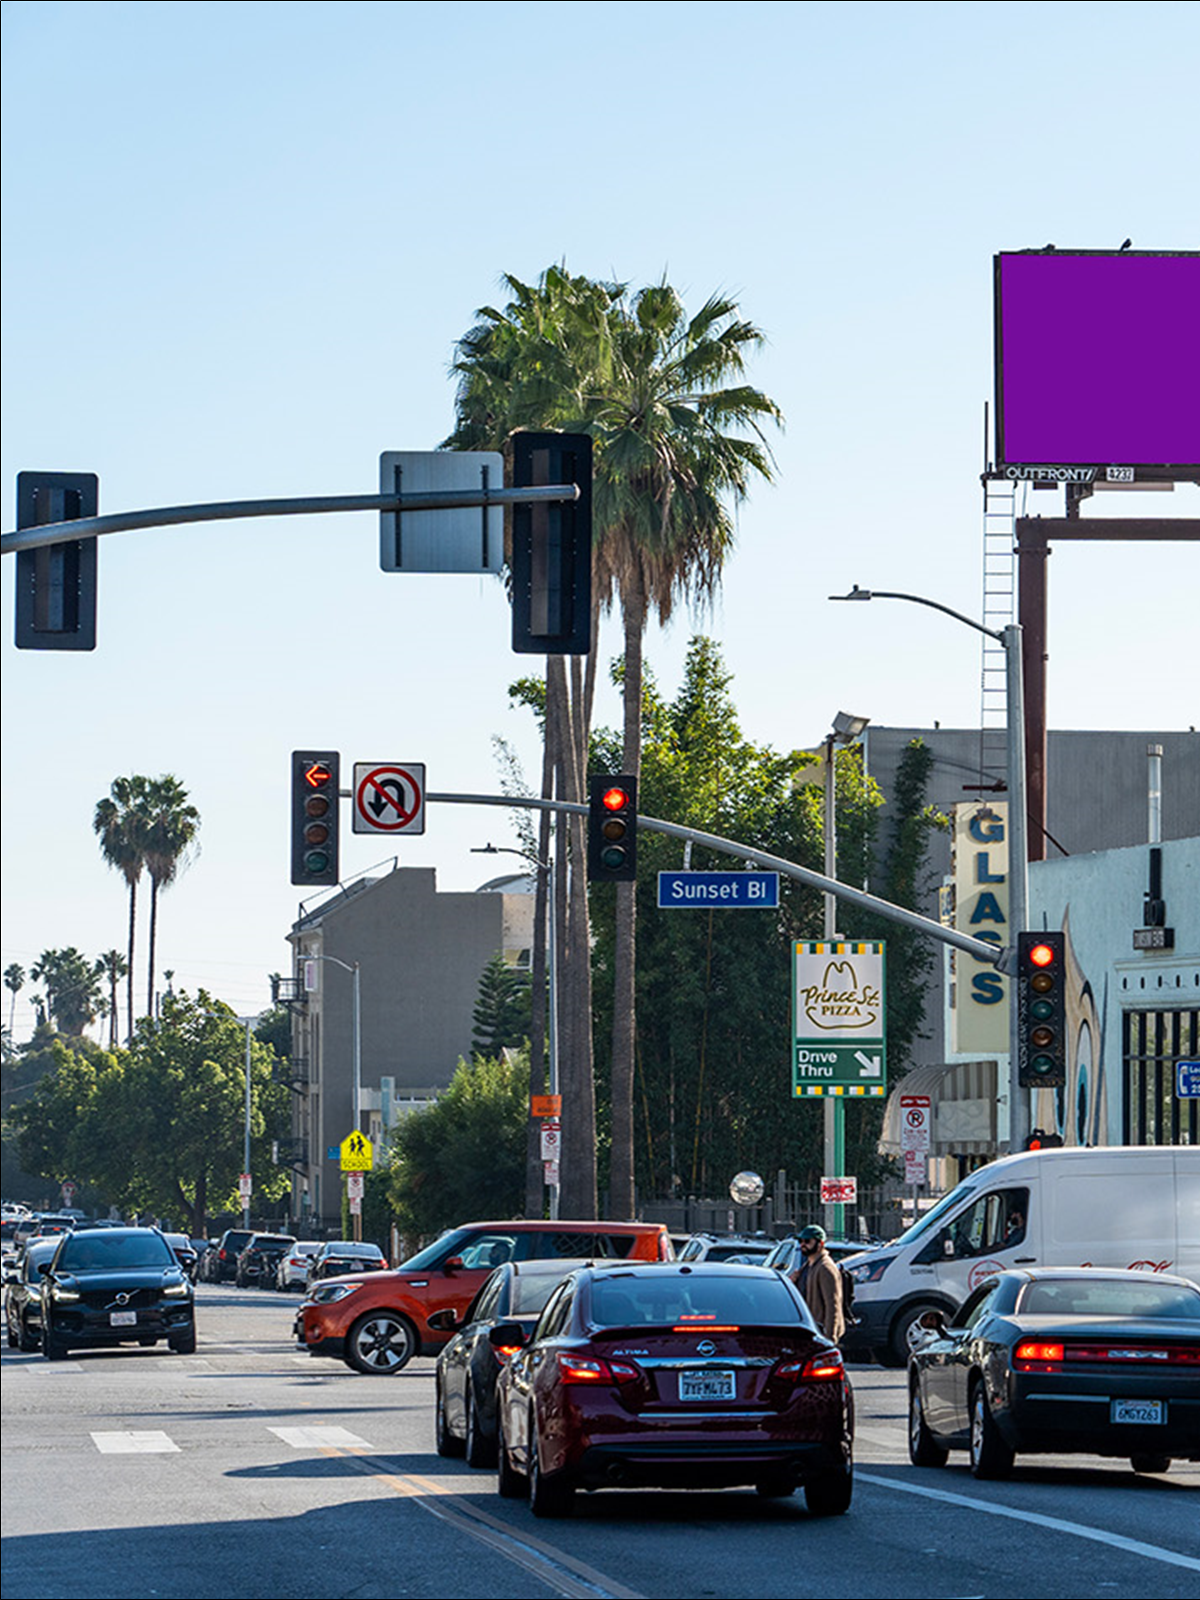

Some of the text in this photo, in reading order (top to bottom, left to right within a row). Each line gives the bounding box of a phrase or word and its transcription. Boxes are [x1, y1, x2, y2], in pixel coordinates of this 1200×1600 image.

[671, 880, 766, 899] Sunset Bl
[801, 985, 880, 1007] Prince St.
[821, 1005, 861, 1016] PIZZA
[799, 1050, 837, 1063] Drive
[799, 1064, 833, 1076] Thru
[343, 1160, 369, 1169] SCHOOL
